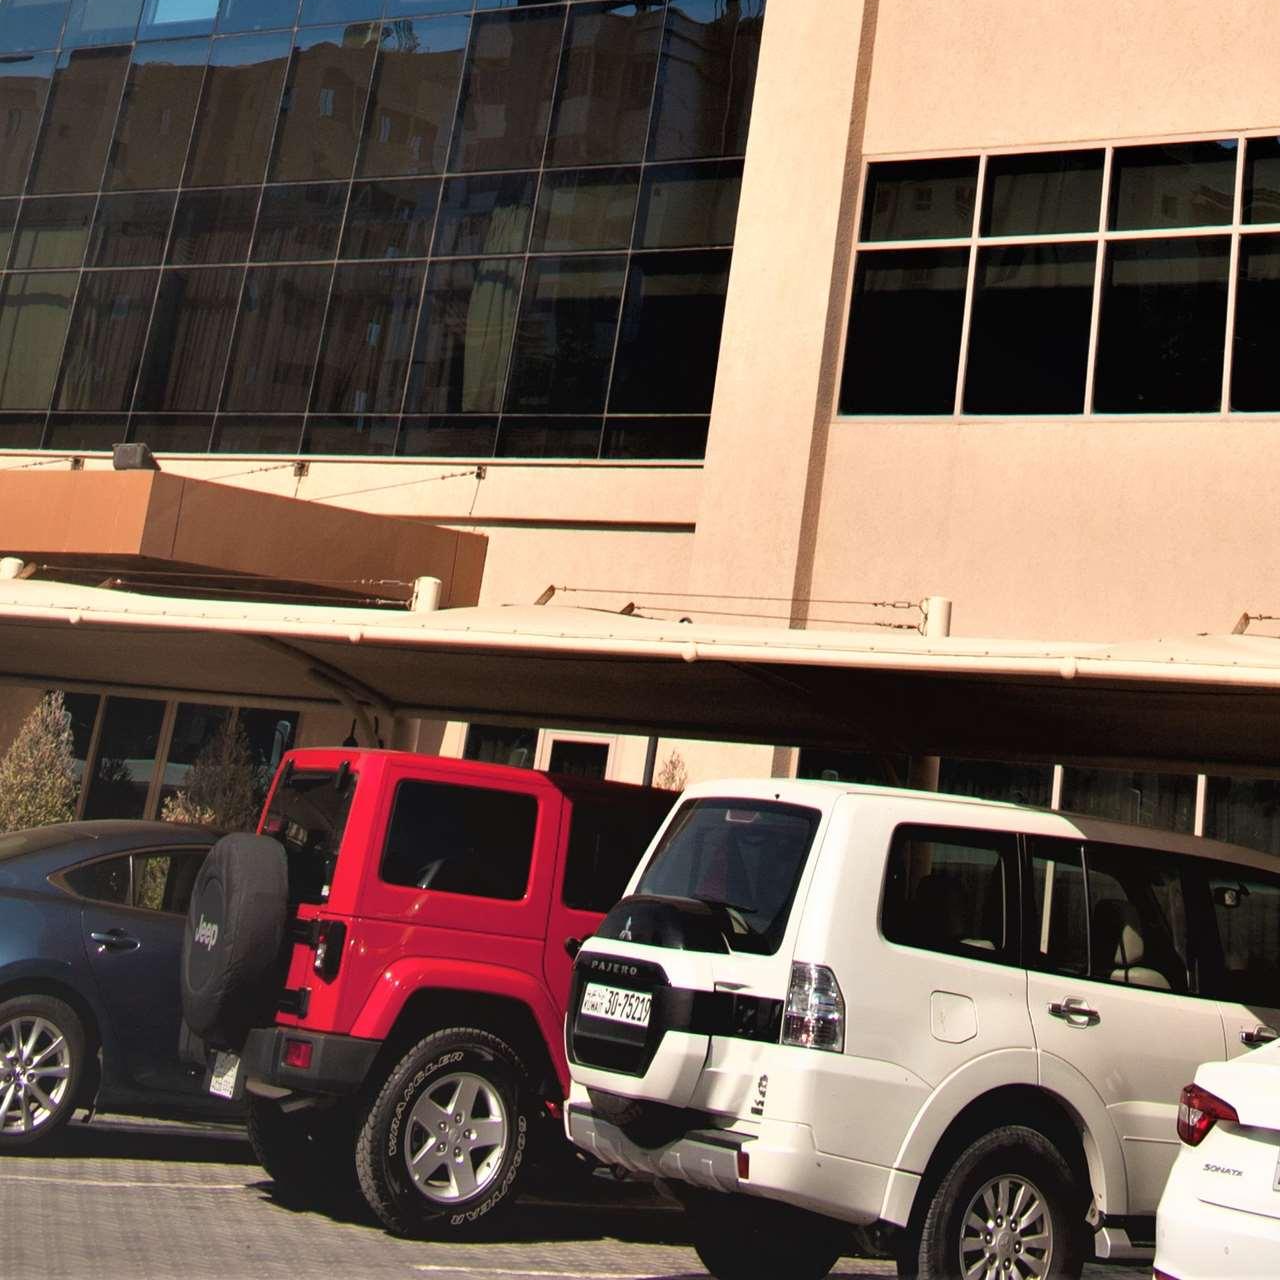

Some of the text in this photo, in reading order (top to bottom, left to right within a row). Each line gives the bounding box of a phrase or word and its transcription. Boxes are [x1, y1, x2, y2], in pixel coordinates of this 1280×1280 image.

[195, 913, 218, 951] Jeep
[591, 960, 638, 976] PAJERO
[451, 1115, 527, 1225] GOODYEAR
[1203, 1163, 1243, 1176] SONATA
